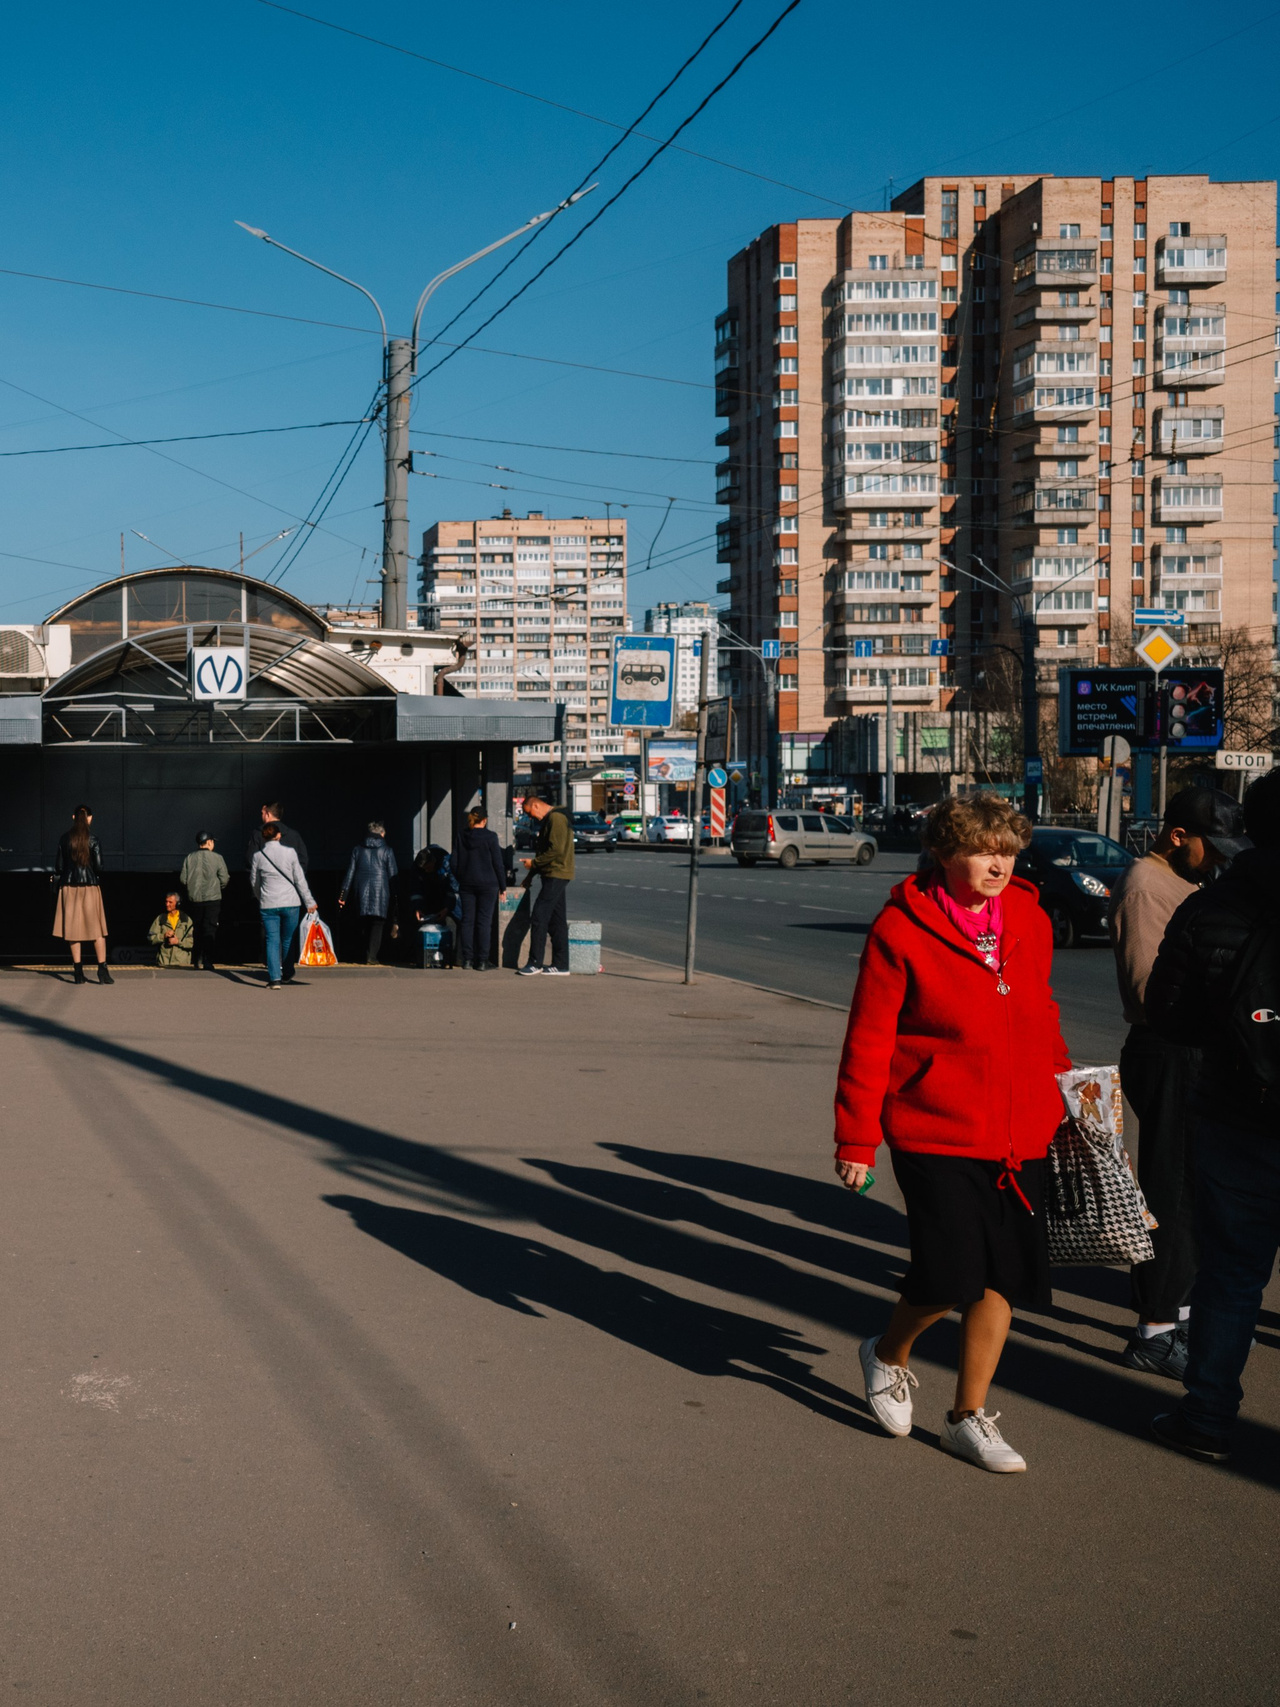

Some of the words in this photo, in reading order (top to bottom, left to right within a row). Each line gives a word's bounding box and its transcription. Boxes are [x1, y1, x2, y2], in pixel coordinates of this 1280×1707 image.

[1095, 683, 1109, 692] VK
[1077, 703, 1107, 711] место
[1077, 713, 1117, 722] встречи
[1224, 754, 1265, 766] СТОП
